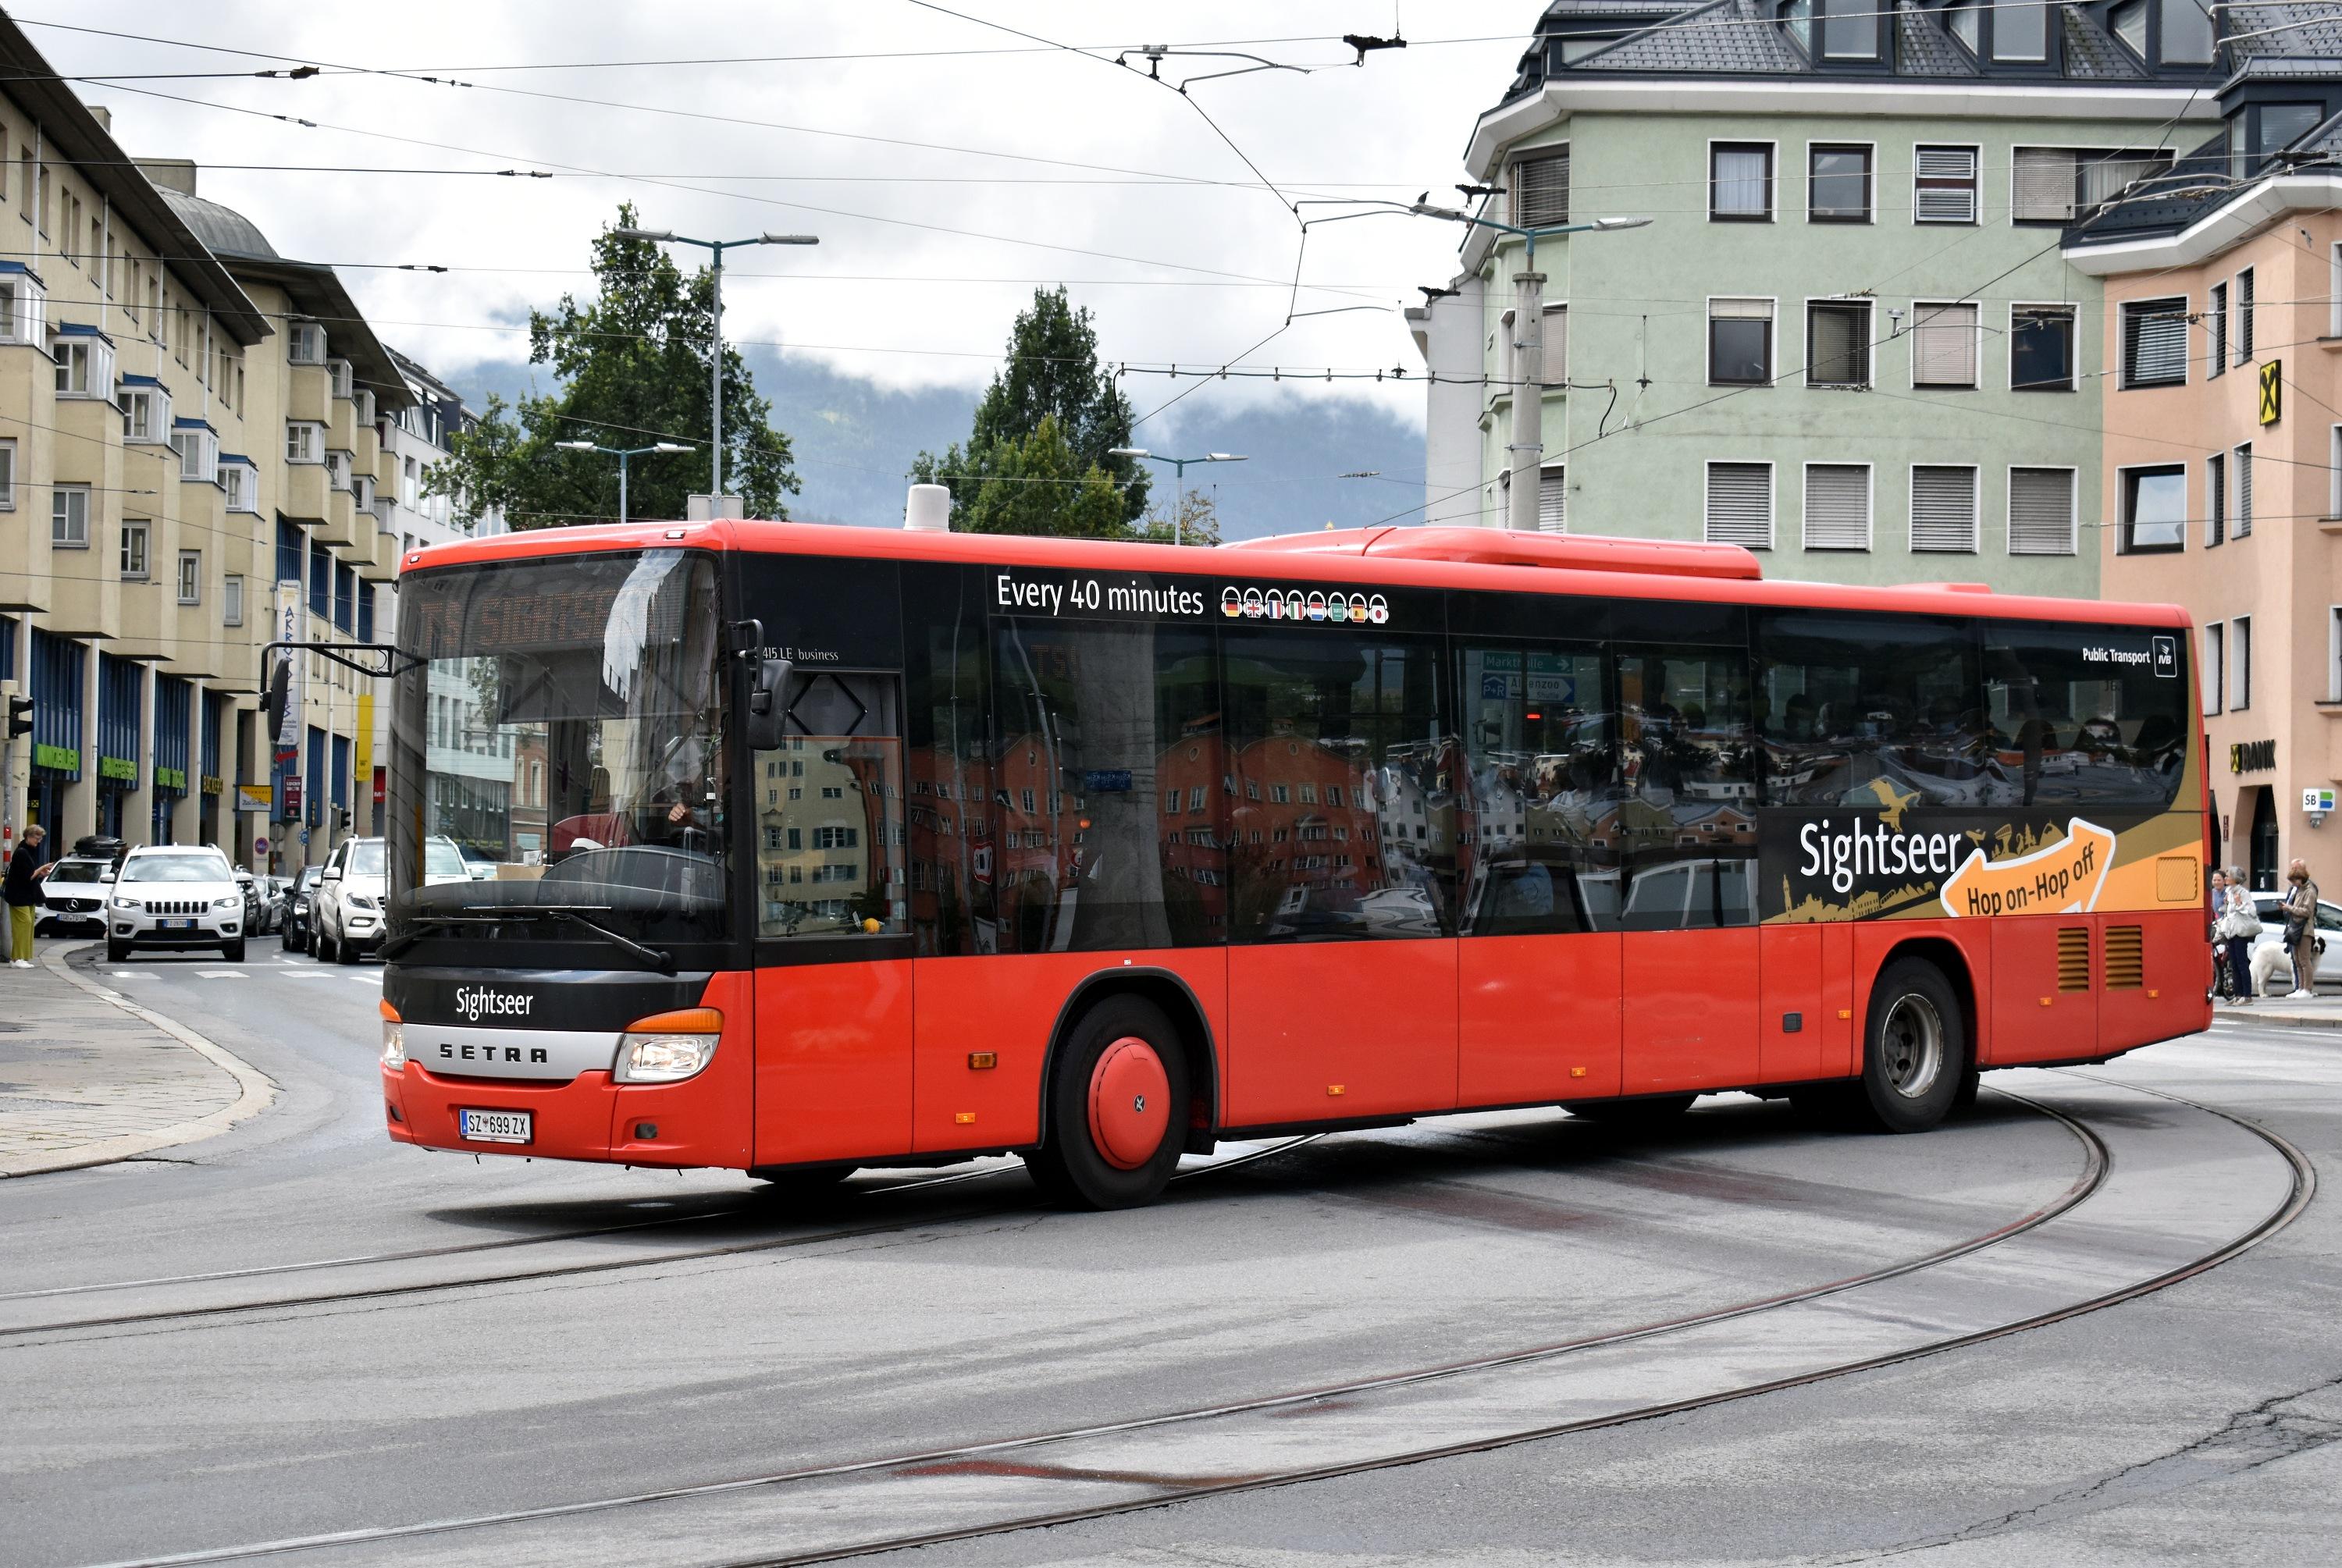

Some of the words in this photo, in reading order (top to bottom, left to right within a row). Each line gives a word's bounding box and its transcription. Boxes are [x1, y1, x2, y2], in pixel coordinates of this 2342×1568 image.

[996, 574, 1062, 616] Every
[1070, 579, 1101, 610] 40
[1107, 580, 1205, 615] minutes
[763, 646, 778, 659] 415
[779, 647, 793, 660] LE
[797, 648, 839, 660] business
[1486, 655, 1544, 669] Markthlle
[2082, 647, 2109, 662] Public
[2109, 648, 2151, 666] Transport
[2158, 655, 2172, 665] IVB
[1483, 684, 1505, 697] P+R
[1511, 677, 1560, 689] Alenzoo
[2242, 739, 2276, 772] BANK
[2305, 795, 2316, 805] SB
[1799, 816, 1962, 894] Sightseer
[1966, 887, 2002, 916] Hop
[2006, 865, 2070, 910] on-Hop
[2073, 841, 2095, 881] off
[456, 985, 534, 1022] Sightseer
[440, 1043, 548, 1063] SETRA
[468, 1115, 482, 1132] SZ
[489, 1116, 510, 1134] 699
[512, 1117, 526, 1135] ZX
